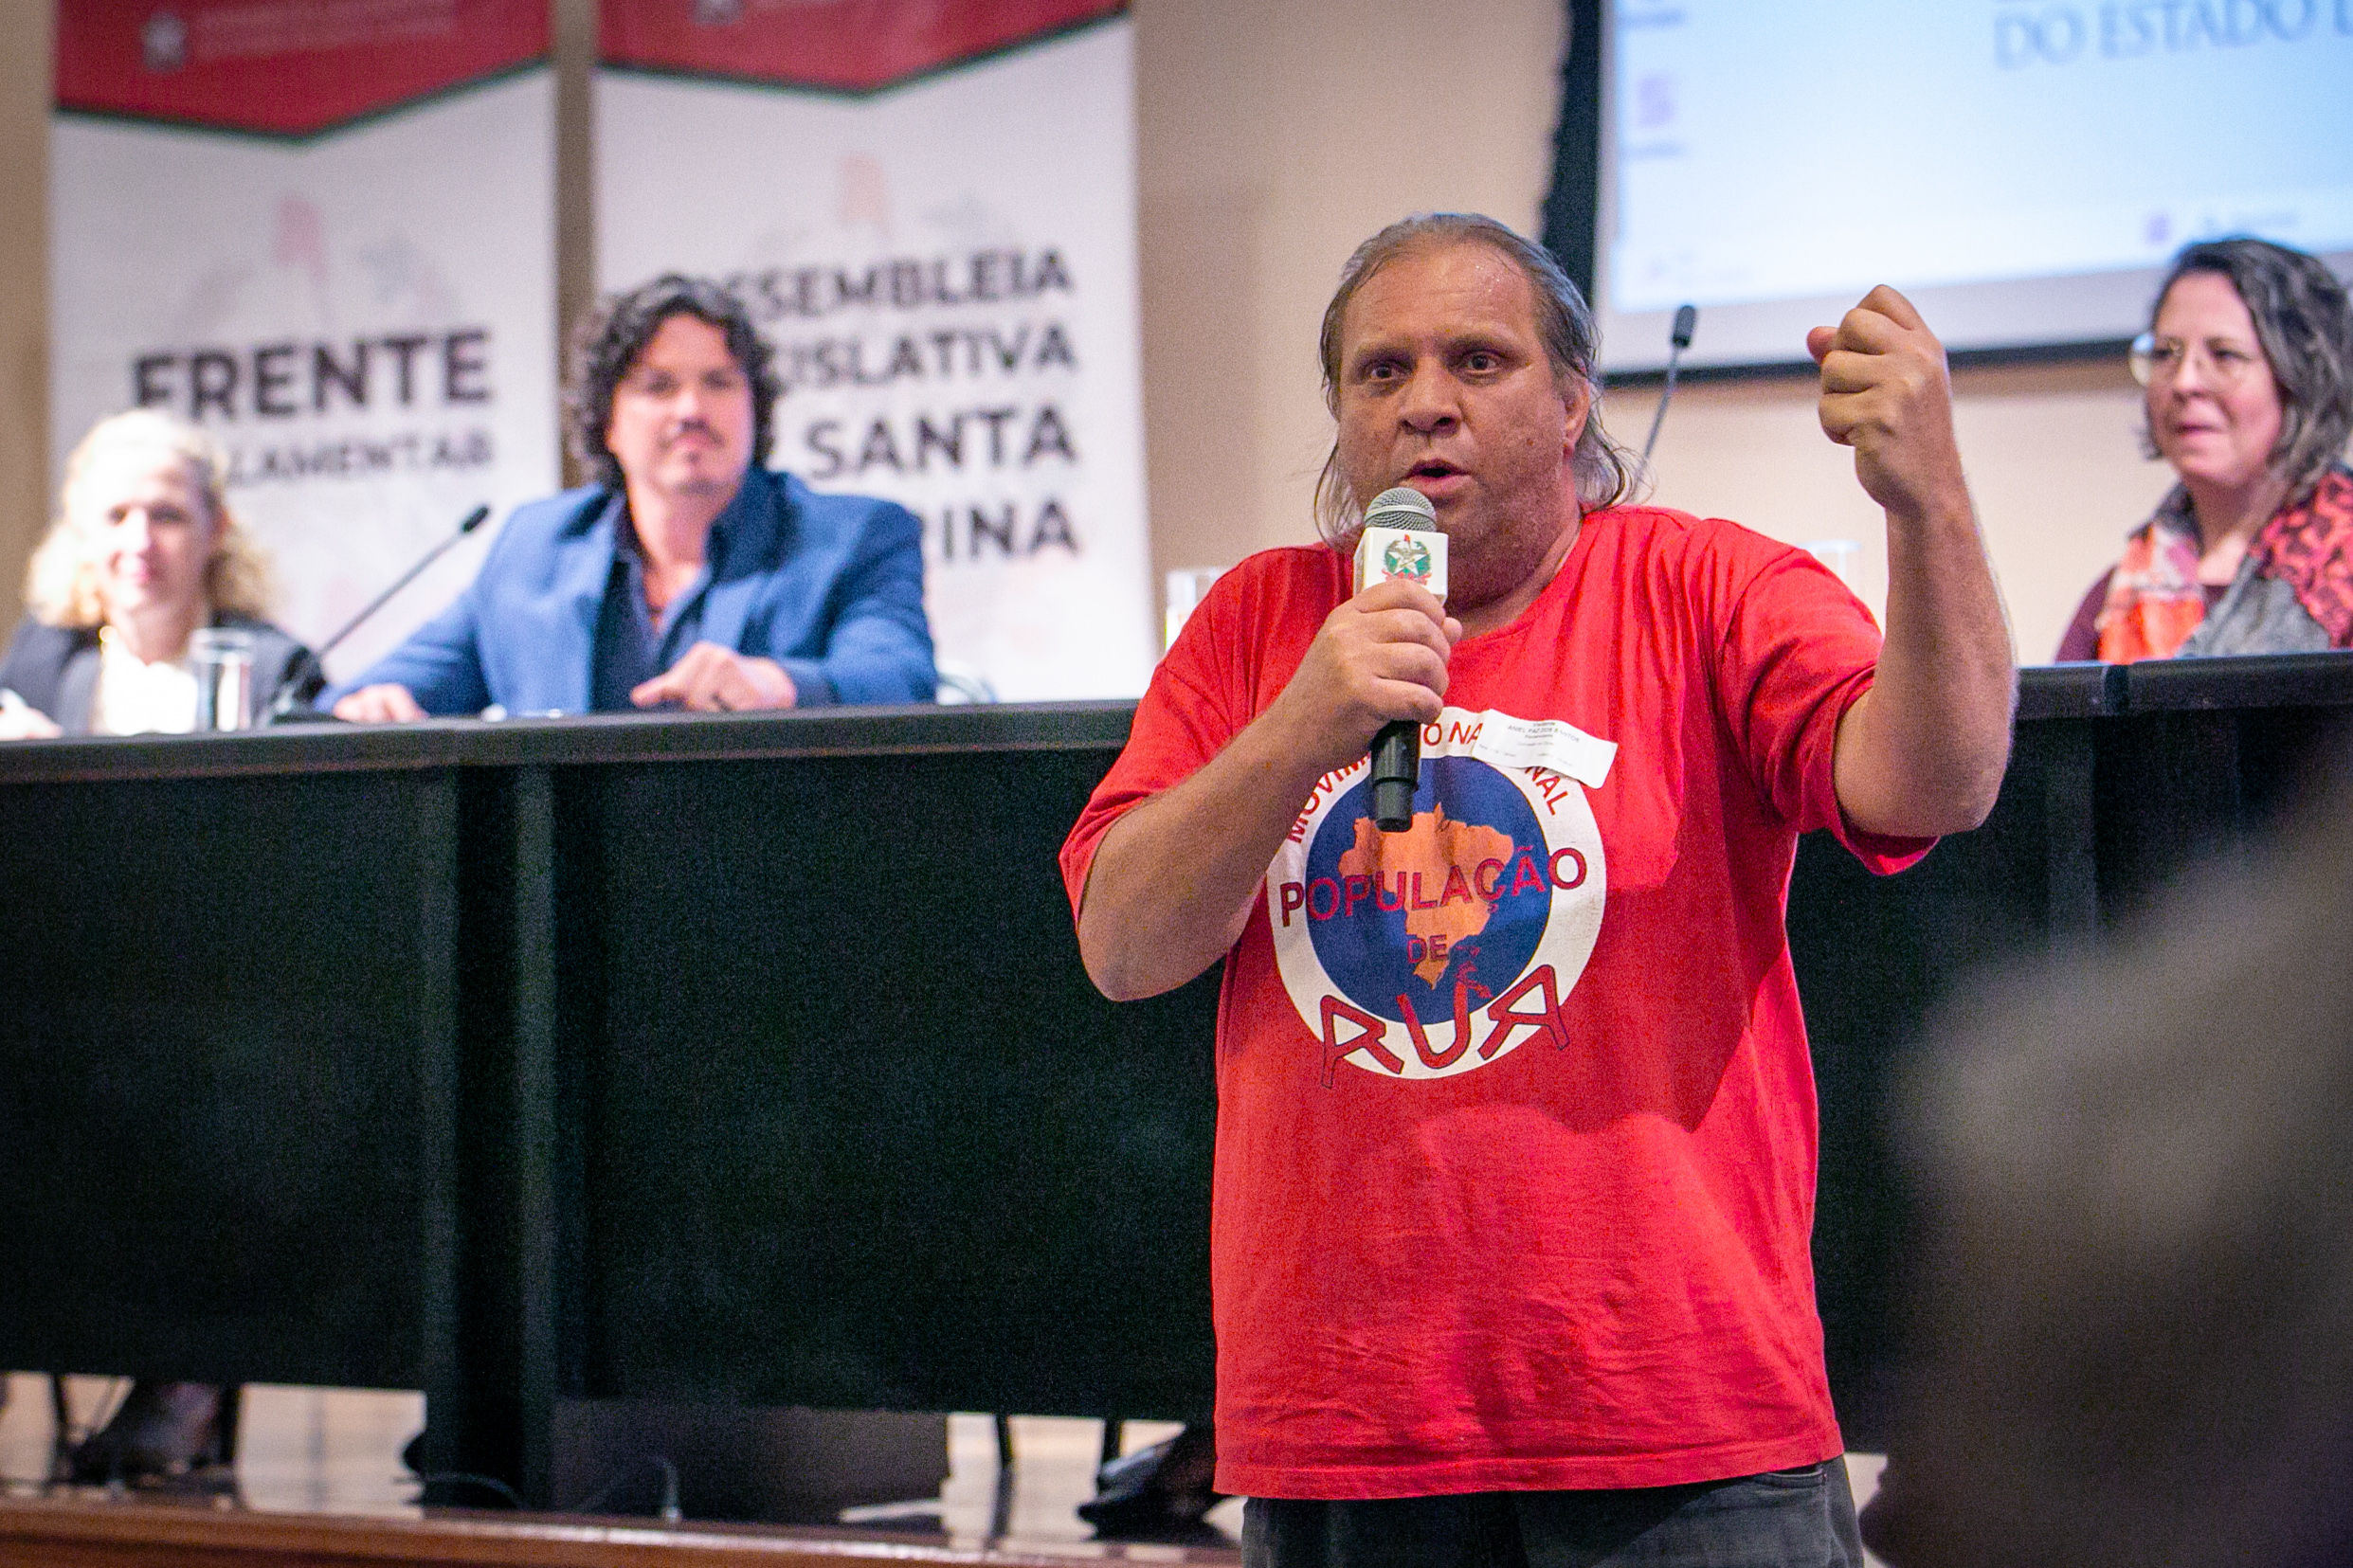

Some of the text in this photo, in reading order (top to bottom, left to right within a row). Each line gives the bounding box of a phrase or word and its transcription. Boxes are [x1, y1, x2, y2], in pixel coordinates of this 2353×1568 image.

[728, 248, 1073, 320] SEMBLEIA
[131, 328, 494, 419] FRENTE
[792, 324, 1078, 387] ISLATIVA
[226, 429, 494, 487] LAMENTAR
[803, 405, 1077, 477] SANTA
[1279, 844, 1587, 928] POPULAÇÃO
[1407, 934, 1449, 964] DE
[1320, 964, 1570, 1089] RUA
